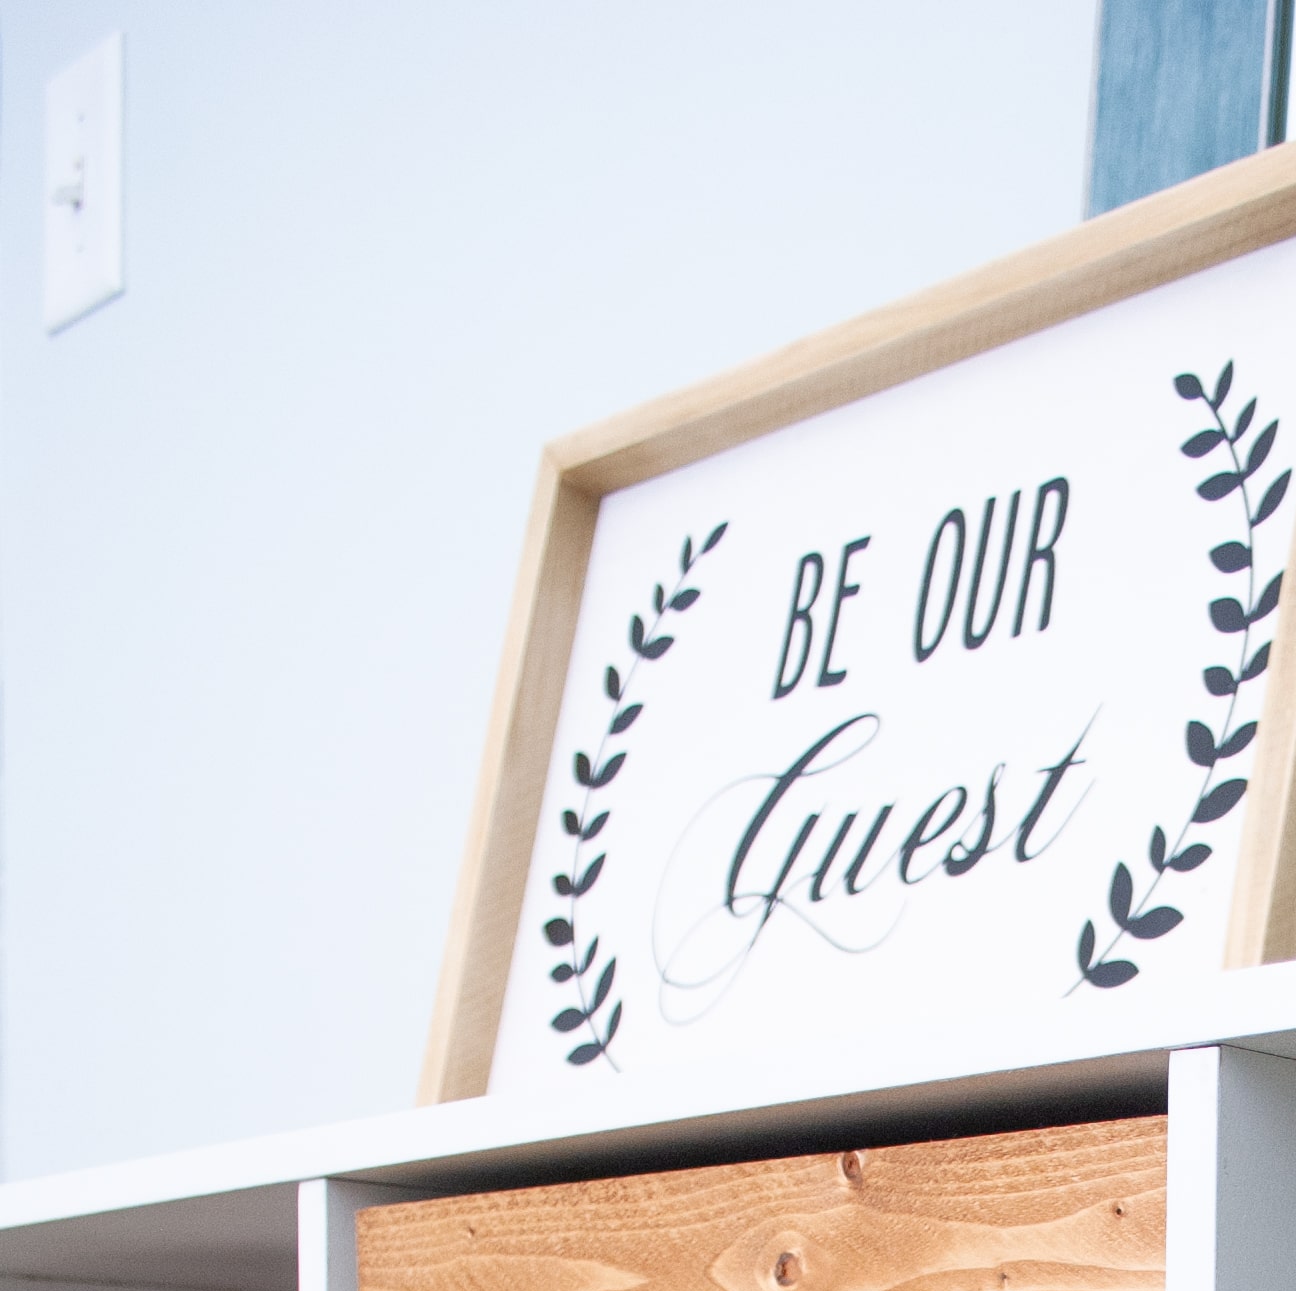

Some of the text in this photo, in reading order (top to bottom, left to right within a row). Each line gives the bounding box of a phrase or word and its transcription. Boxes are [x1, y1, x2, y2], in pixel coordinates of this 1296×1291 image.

[771, 476, 1070, 700] BE OUR
[652, 702, 1103, 1027] Guest
